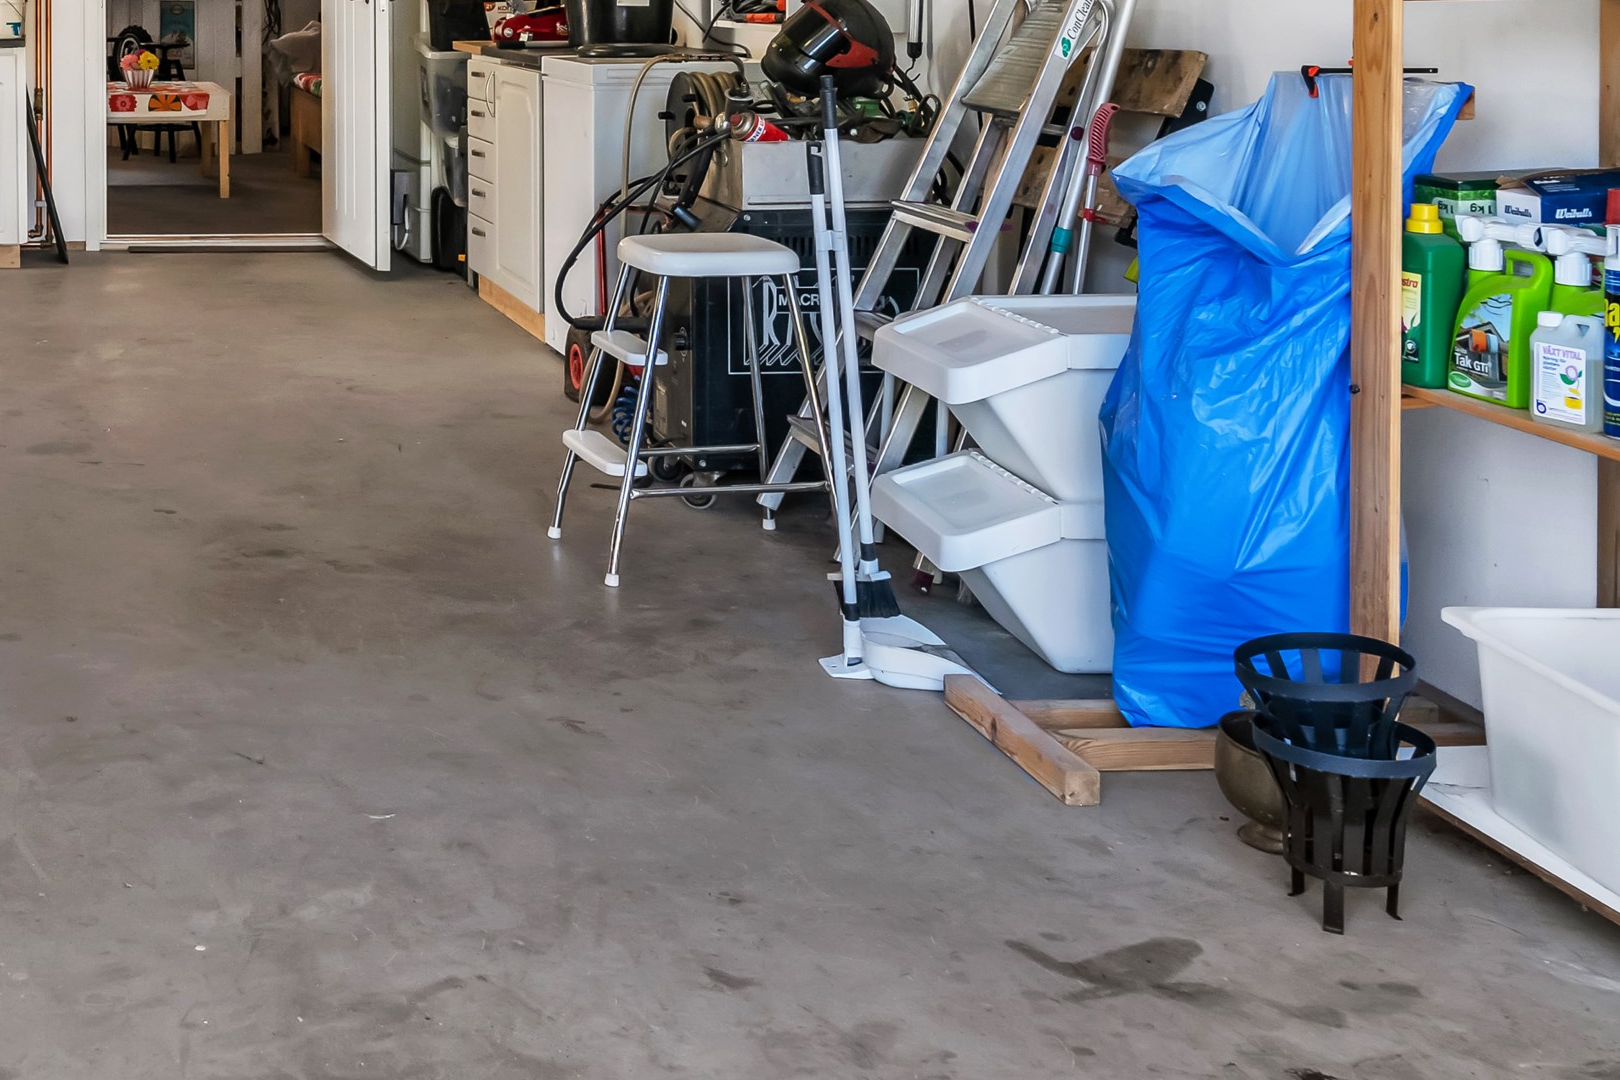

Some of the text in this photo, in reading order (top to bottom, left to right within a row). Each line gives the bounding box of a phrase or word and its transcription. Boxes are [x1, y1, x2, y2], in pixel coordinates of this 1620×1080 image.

[1469, 203, 1485, 215] kg
[1454, 351, 1472, 369] Tak
[1562, 350, 1582, 361] VITAL
